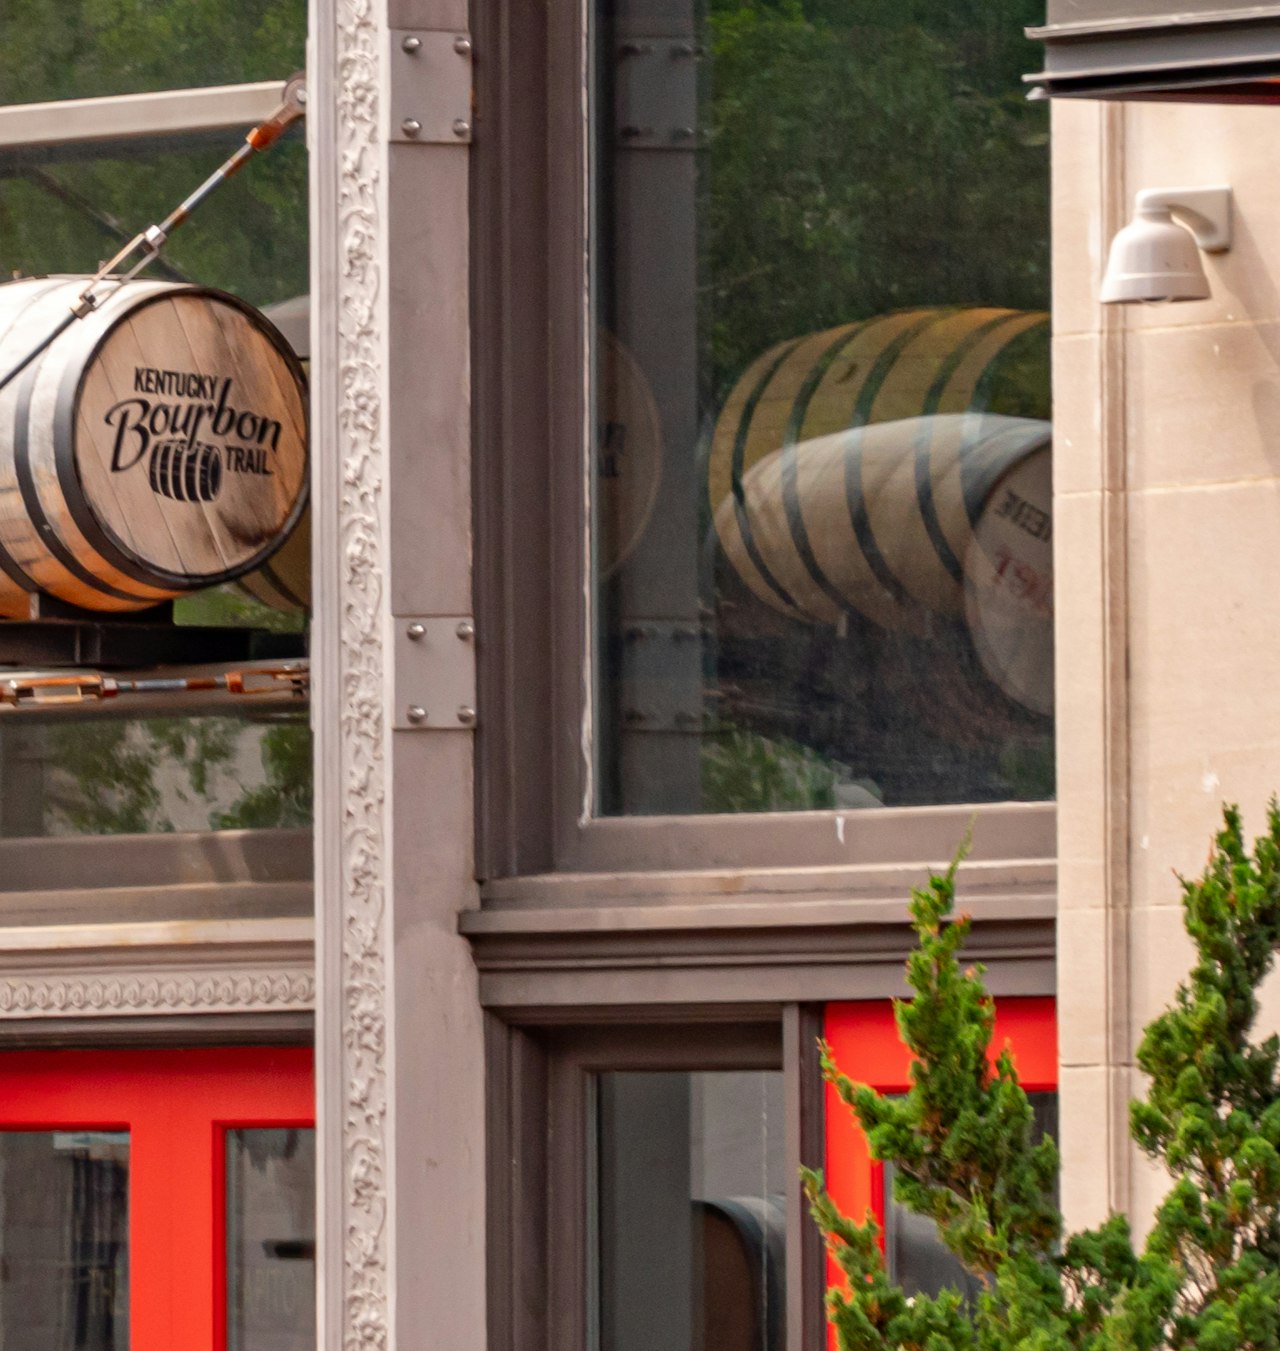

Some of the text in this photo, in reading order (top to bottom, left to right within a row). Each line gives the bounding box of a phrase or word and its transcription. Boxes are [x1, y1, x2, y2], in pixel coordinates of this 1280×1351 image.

[134, 366, 218, 400] KENTUCKY
[104, 377, 282, 473] Bourbon
[225, 444, 272, 475] TRAIL
